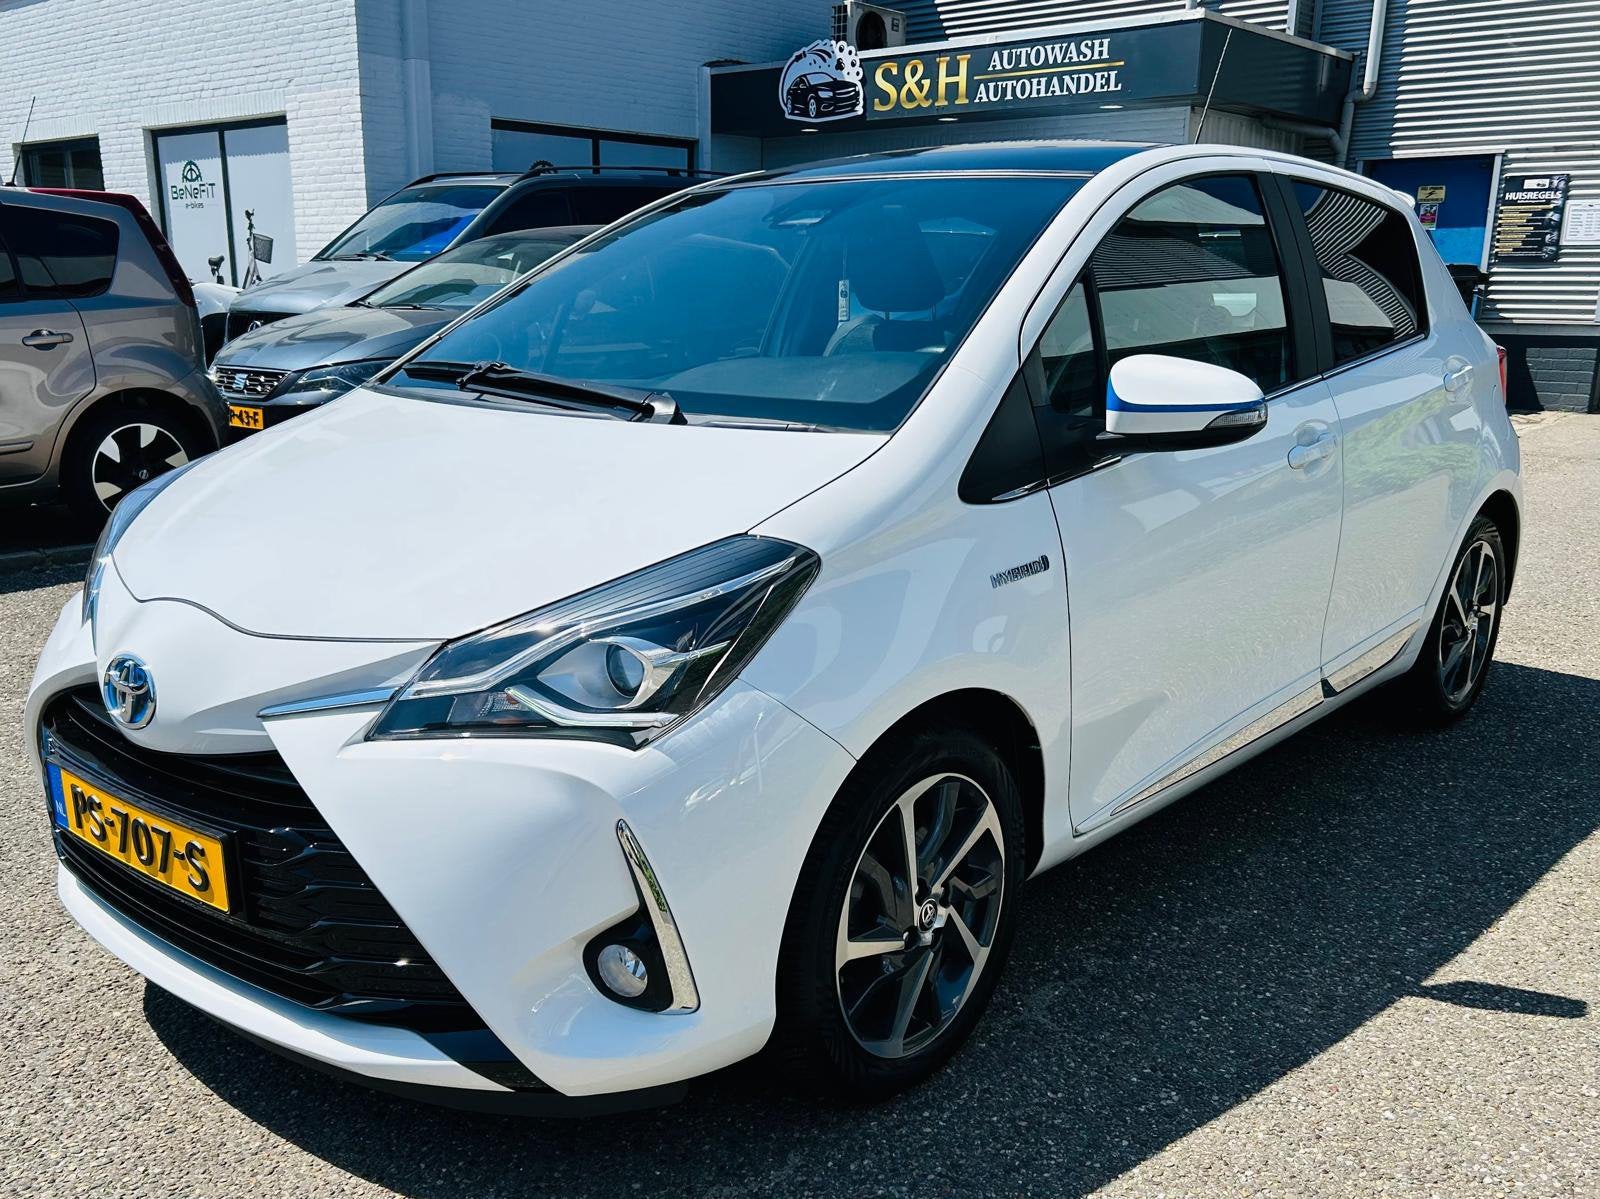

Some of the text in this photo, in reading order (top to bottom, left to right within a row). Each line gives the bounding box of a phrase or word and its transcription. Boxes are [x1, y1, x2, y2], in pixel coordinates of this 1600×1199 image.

[988, 38, 1111, 71] AUTOWASH
[874, 54, 971, 112] S&H
[974, 70, 1122, 103] AUTOHANDEL
[1505, 190, 1562, 201] HUISREGELS
[990, 557, 1043, 589] HYBRID
[55, 799, 67, 817] NL
[70, 783, 210, 892] PS-707-S
